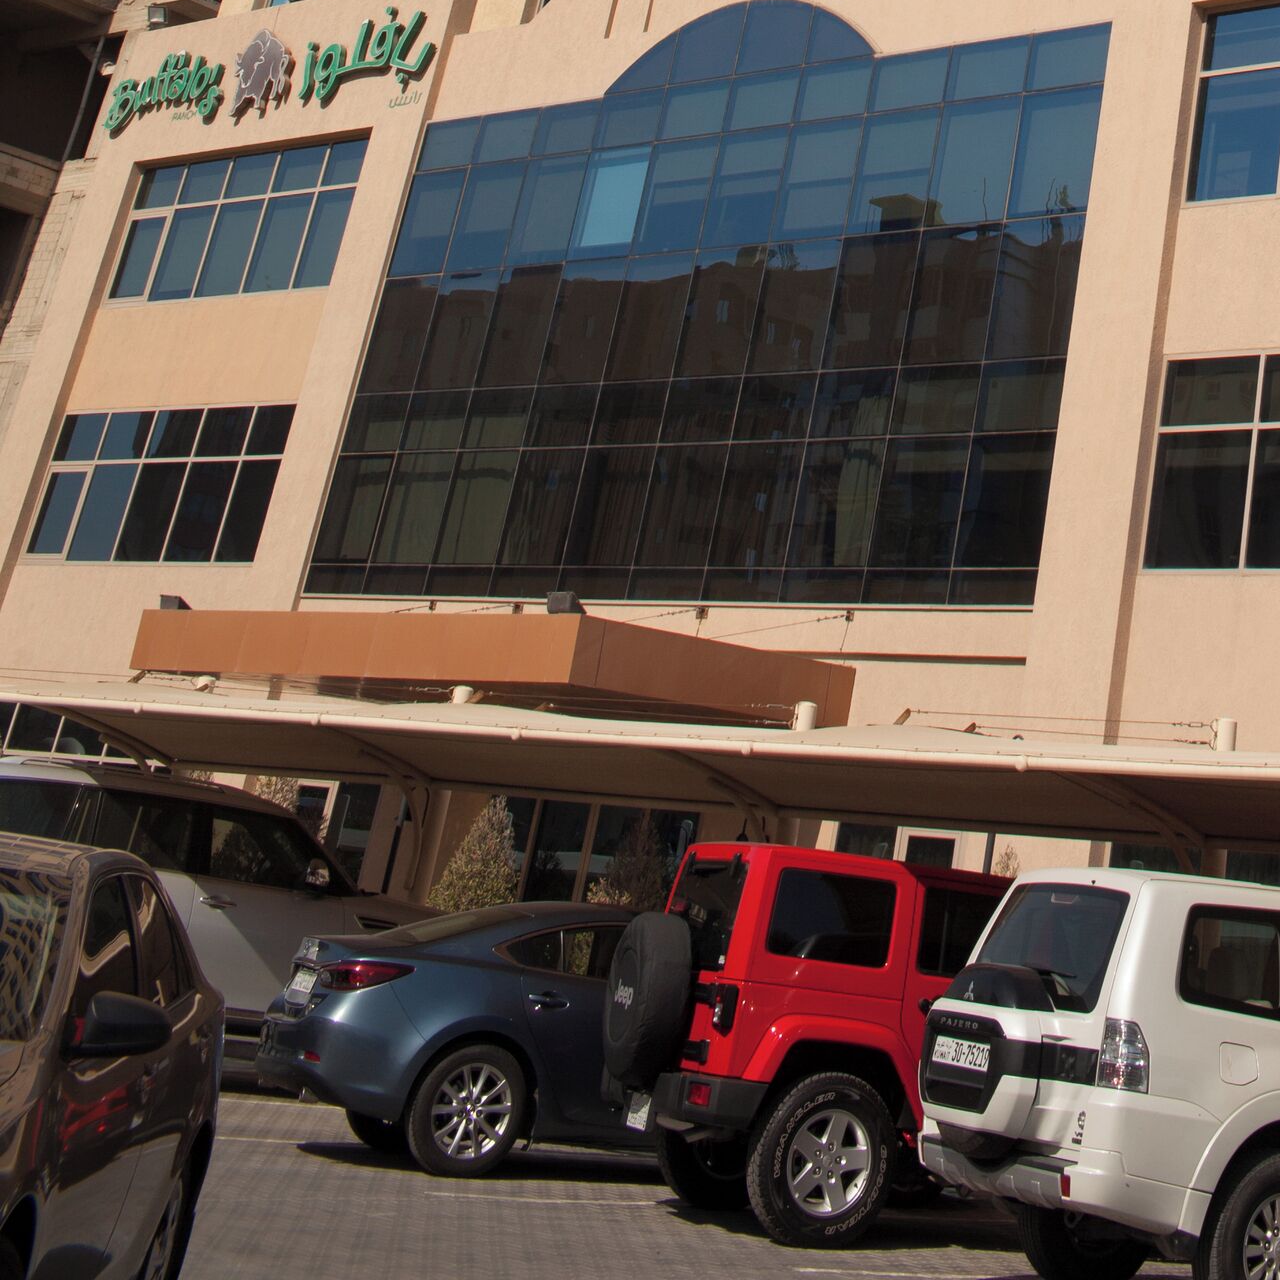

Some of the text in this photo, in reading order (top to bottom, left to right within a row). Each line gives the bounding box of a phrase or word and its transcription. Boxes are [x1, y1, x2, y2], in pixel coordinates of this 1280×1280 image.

[298, 6, 434, 100] بافلوز
[614, 978, 634, 1010] Jeep
[940, 1017, 978, 1029] PAJERO
[774, 1092, 836, 1178] WRANGLER
[825, 1144, 888, 1235] GOODYEAR
